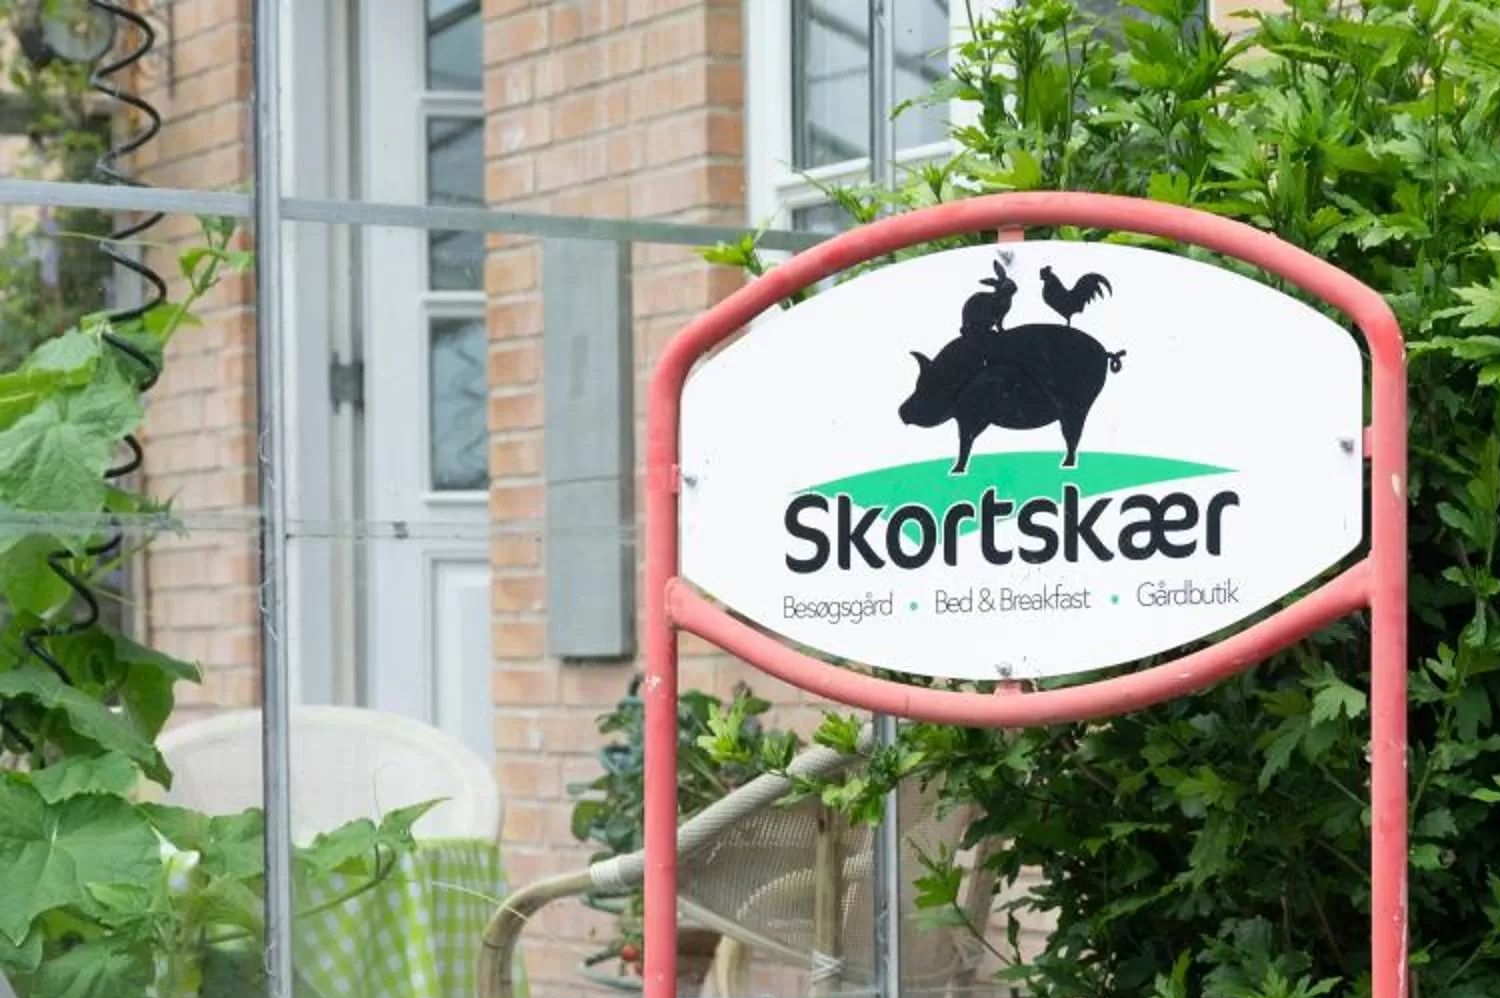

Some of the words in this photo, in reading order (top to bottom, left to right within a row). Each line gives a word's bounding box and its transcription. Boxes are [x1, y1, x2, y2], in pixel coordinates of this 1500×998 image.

[784, 485, 1240, 574] Skortskær
[783, 591, 893, 625] Besøgsgård
[935, 588, 973, 614] Bed
[977, 587, 996, 613] &
[999, 584, 1091, 611] Breakfast
[1137, 578, 1239, 607] Gårdbutik
